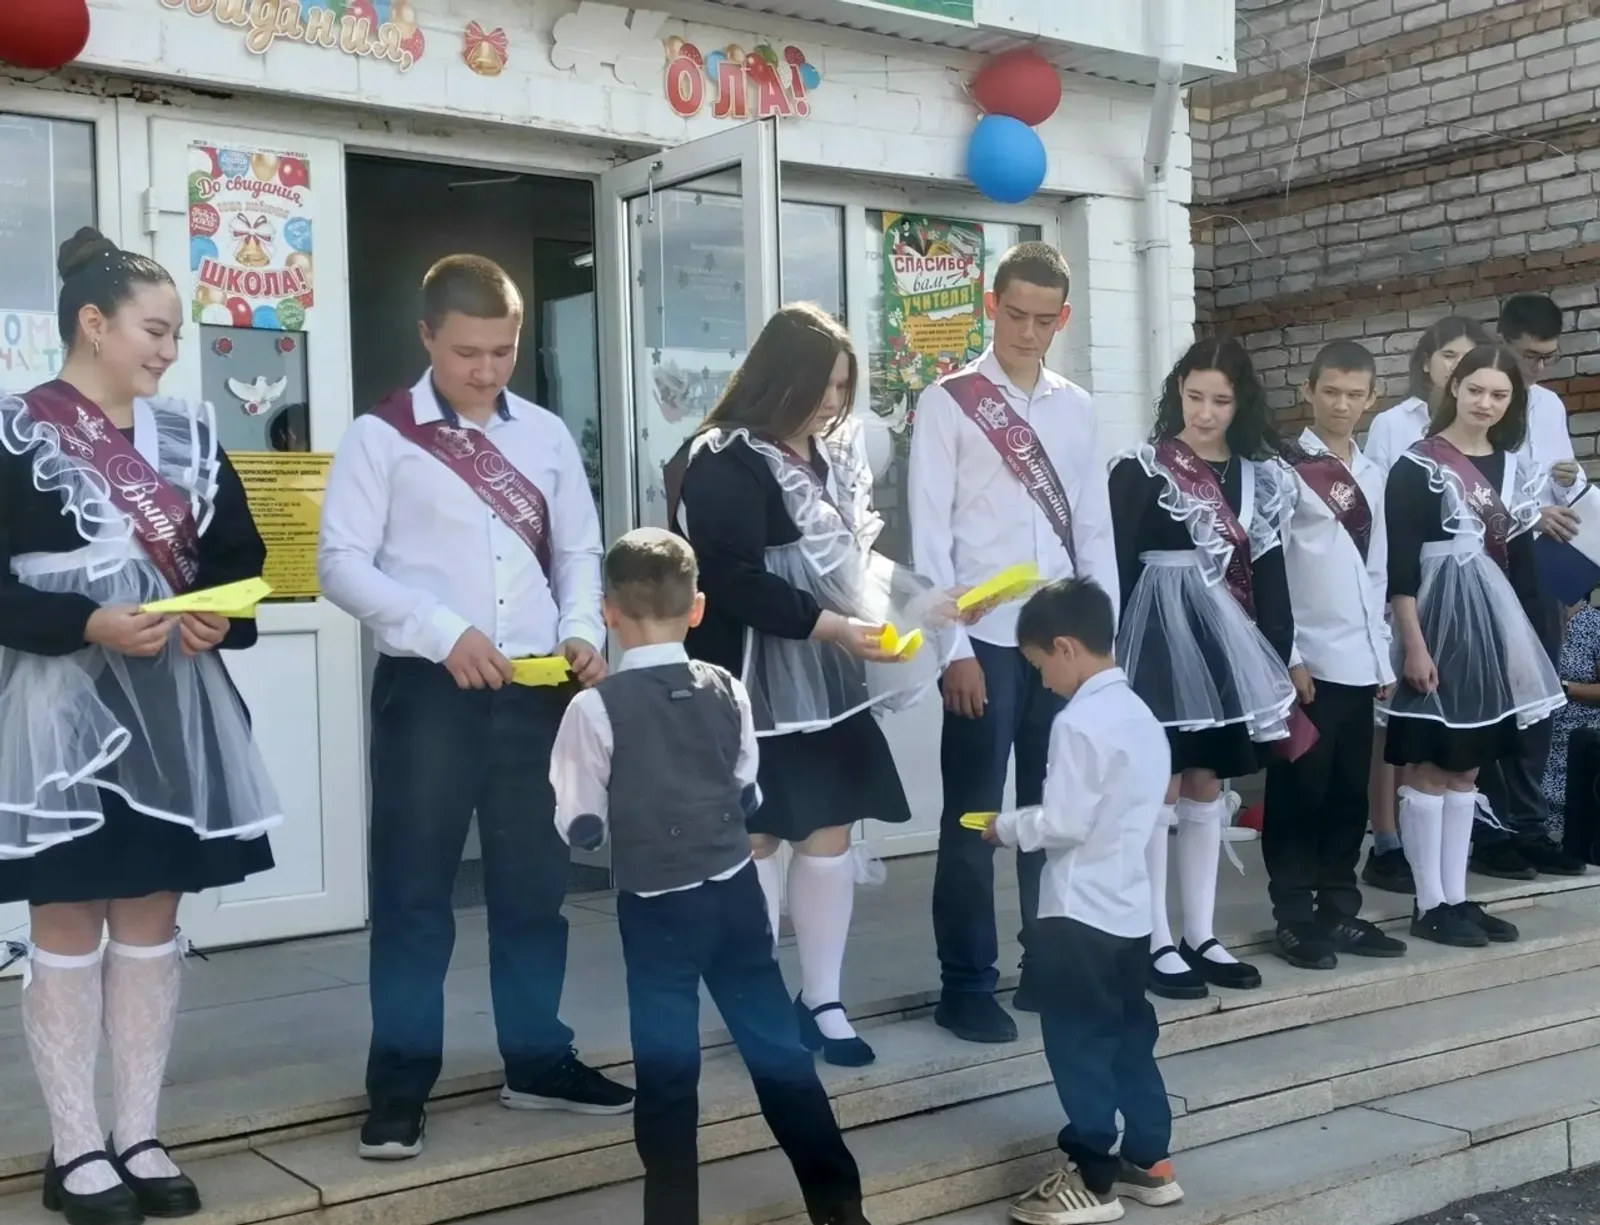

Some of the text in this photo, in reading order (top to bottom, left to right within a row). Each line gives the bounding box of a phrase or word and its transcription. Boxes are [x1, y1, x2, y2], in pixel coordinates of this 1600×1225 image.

[197, 175, 303, 207] До свидания,
[200, 258, 308, 296] ШКОЛА!
[894, 257, 966, 273] СПАСИБО
